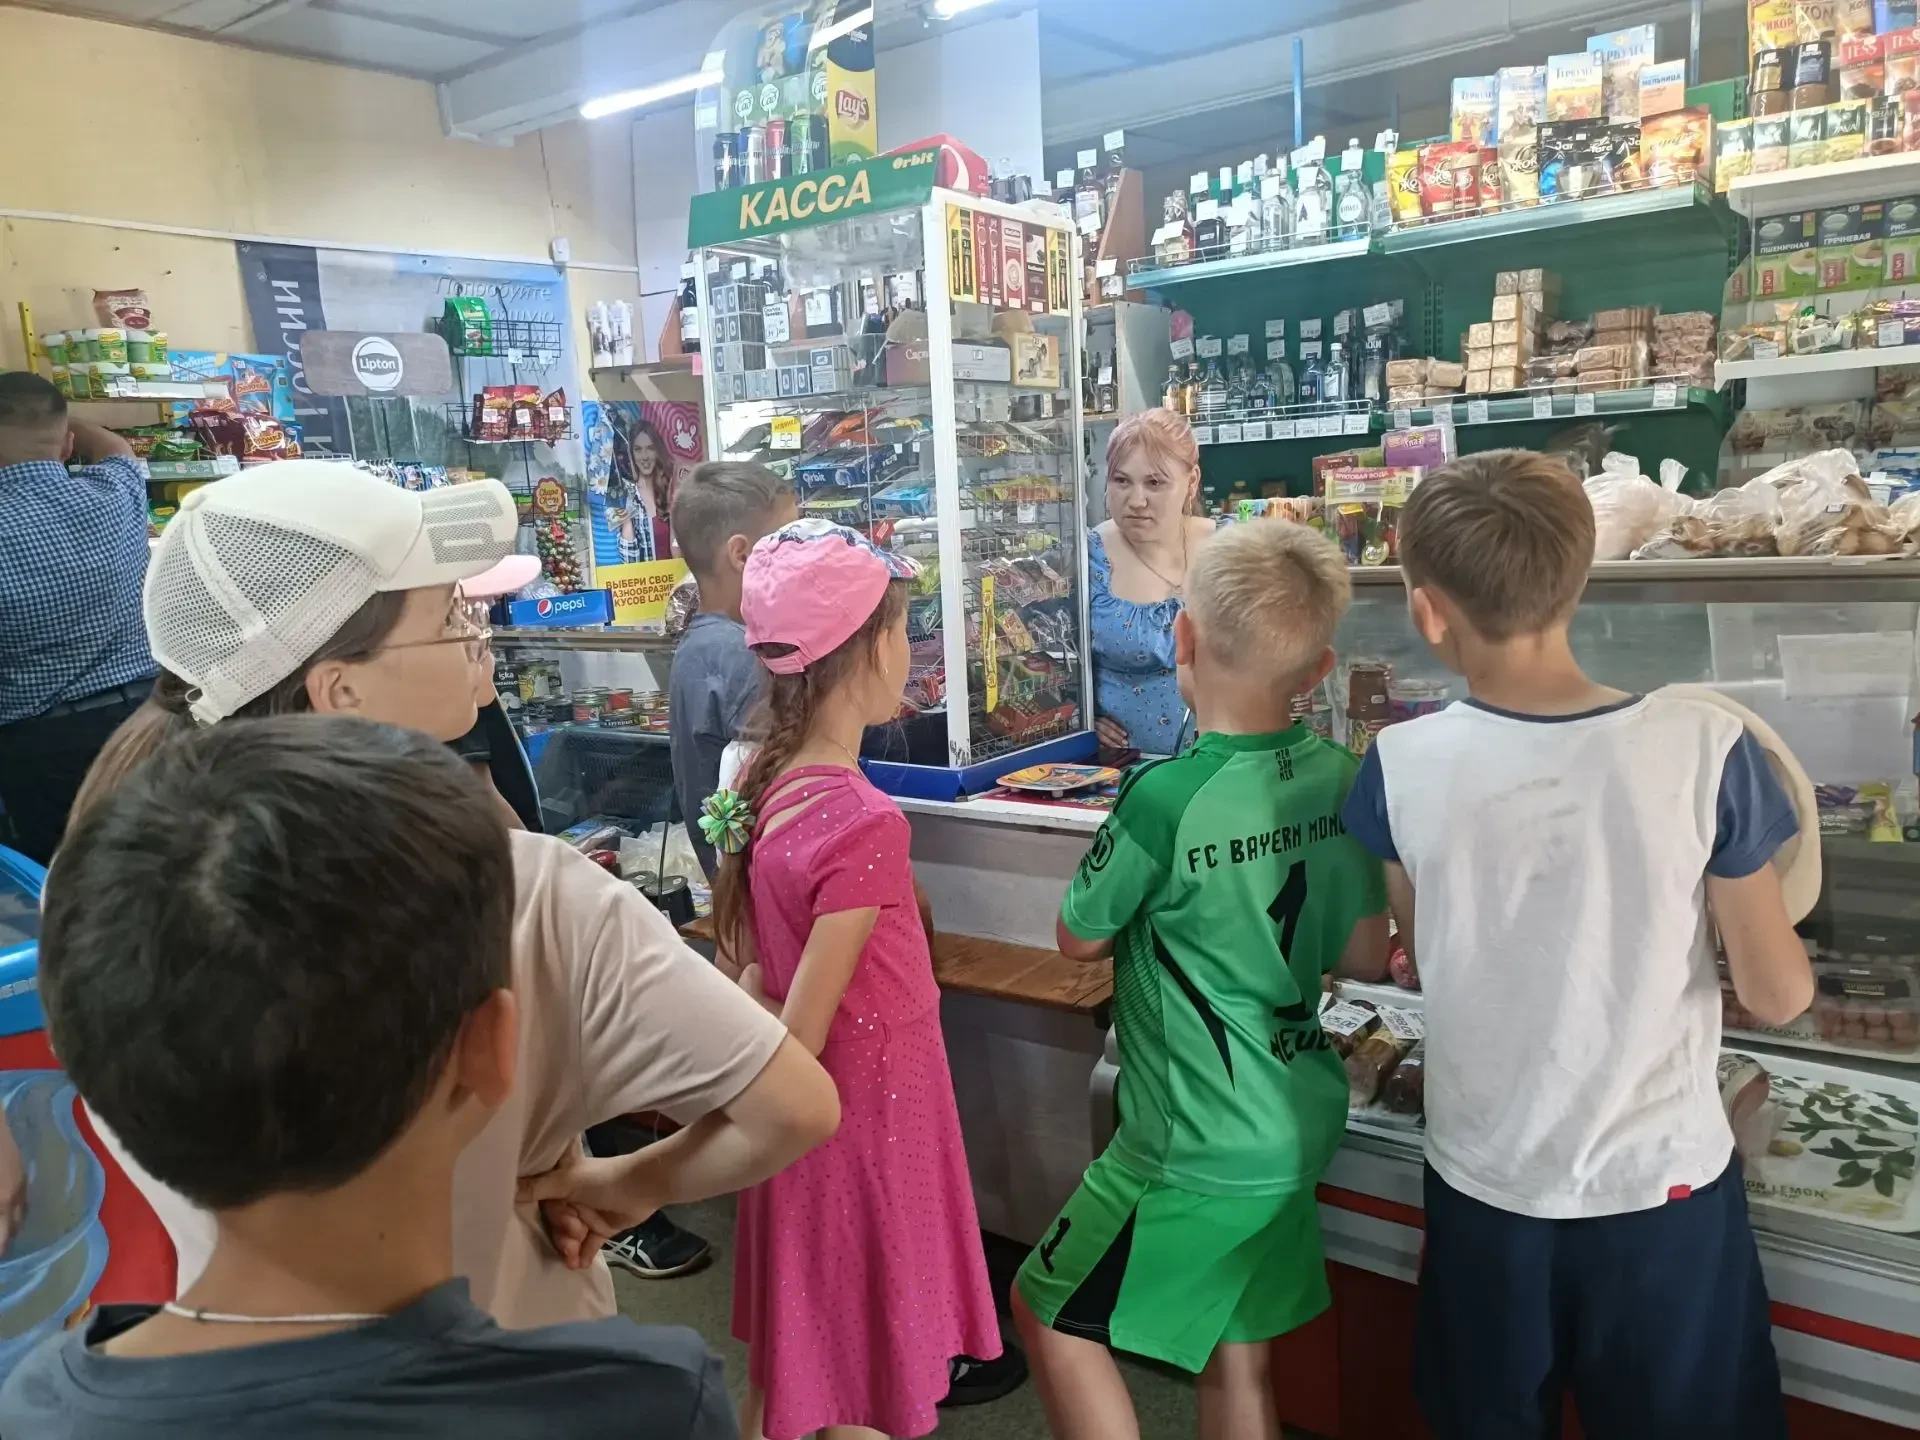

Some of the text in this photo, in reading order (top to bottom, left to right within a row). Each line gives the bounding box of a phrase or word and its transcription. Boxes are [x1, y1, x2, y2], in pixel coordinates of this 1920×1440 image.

[1847, 42, 1878, 59] TESS
[838, 92, 867, 122] Lay's
[892, 152, 934, 170] Orbit
[739, 170, 872, 230] КАССА
[436, 275, 552, 304] Попробуйте
[359, 357, 396, 372] Lipton
[802, 472, 826, 488] Orbit
[606, 574, 675, 590] ВЫБЕРИ СВОЕ
[612, 584, 675, 599] АЗНООБРАЗИЕ
[554, 596, 586, 614] pepsi
[614, 596, 646, 608] КУСОВ
[908, 632, 936, 644] entos
[1187, 844, 1218, 874] FC
[1229, 823, 1302, 864] BAYERN
[1266, 859, 1314, 1022] 1
[1744, 1179, 1767, 1191] ON
[1771, 1184, 1826, 1199] LEMON
[1040, 1216, 1071, 1275] 1
